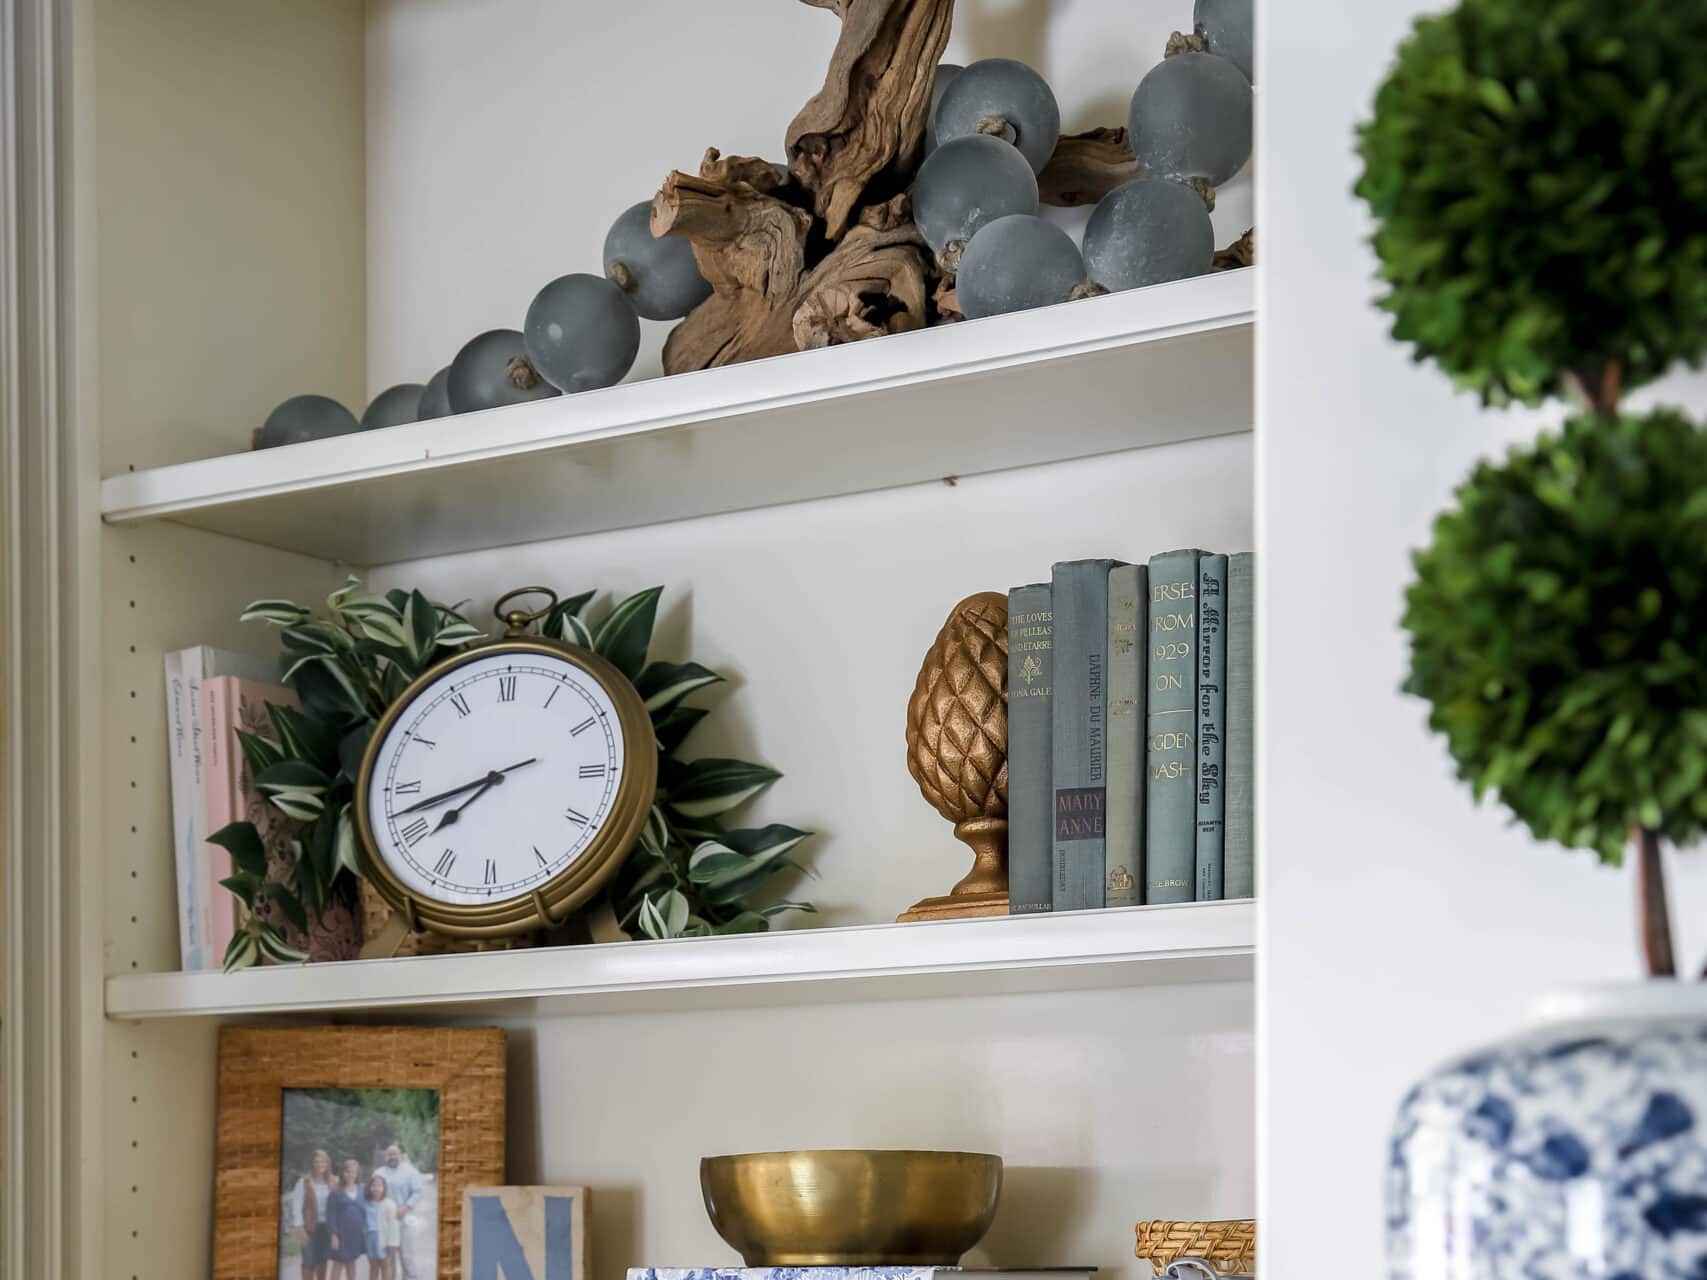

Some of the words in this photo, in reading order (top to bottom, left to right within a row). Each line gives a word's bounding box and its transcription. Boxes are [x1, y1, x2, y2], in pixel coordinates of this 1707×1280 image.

[1026, 611, 1053, 623] LOVES
[1152, 613, 1194, 632] ROM
[1152, 642, 1190, 661] 1929
[1202, 602, 1219, 680] Mirror
[1089, 654, 1101, 700] DAPHNE
[1156, 675, 1182, 691] ON
[497, 675, 517, 702] XII
[450, 692, 472, 718] XI
[1200, 684, 1219, 718] for
[1089, 705, 1101, 722] DU
[569, 716, 597, 737] II
[412, 733, 436, 751] X
[1151, 732, 1193, 751] GDEN
[1202, 723, 1219, 756] the
[1089, 727, 1102, 781] MAURIER
[578, 764, 606, 779] III
[395, 780, 422, 795] IX
[1199, 762, 1219, 805] Sky
[1060, 793, 1101, 812] MARY
[400, 816, 429, 849] VIII
[1059, 816, 1103, 835] ANNE
[432, 848, 457, 878] VII
[532, 845, 548, 869] V
[484, 858, 497, 885] VI
